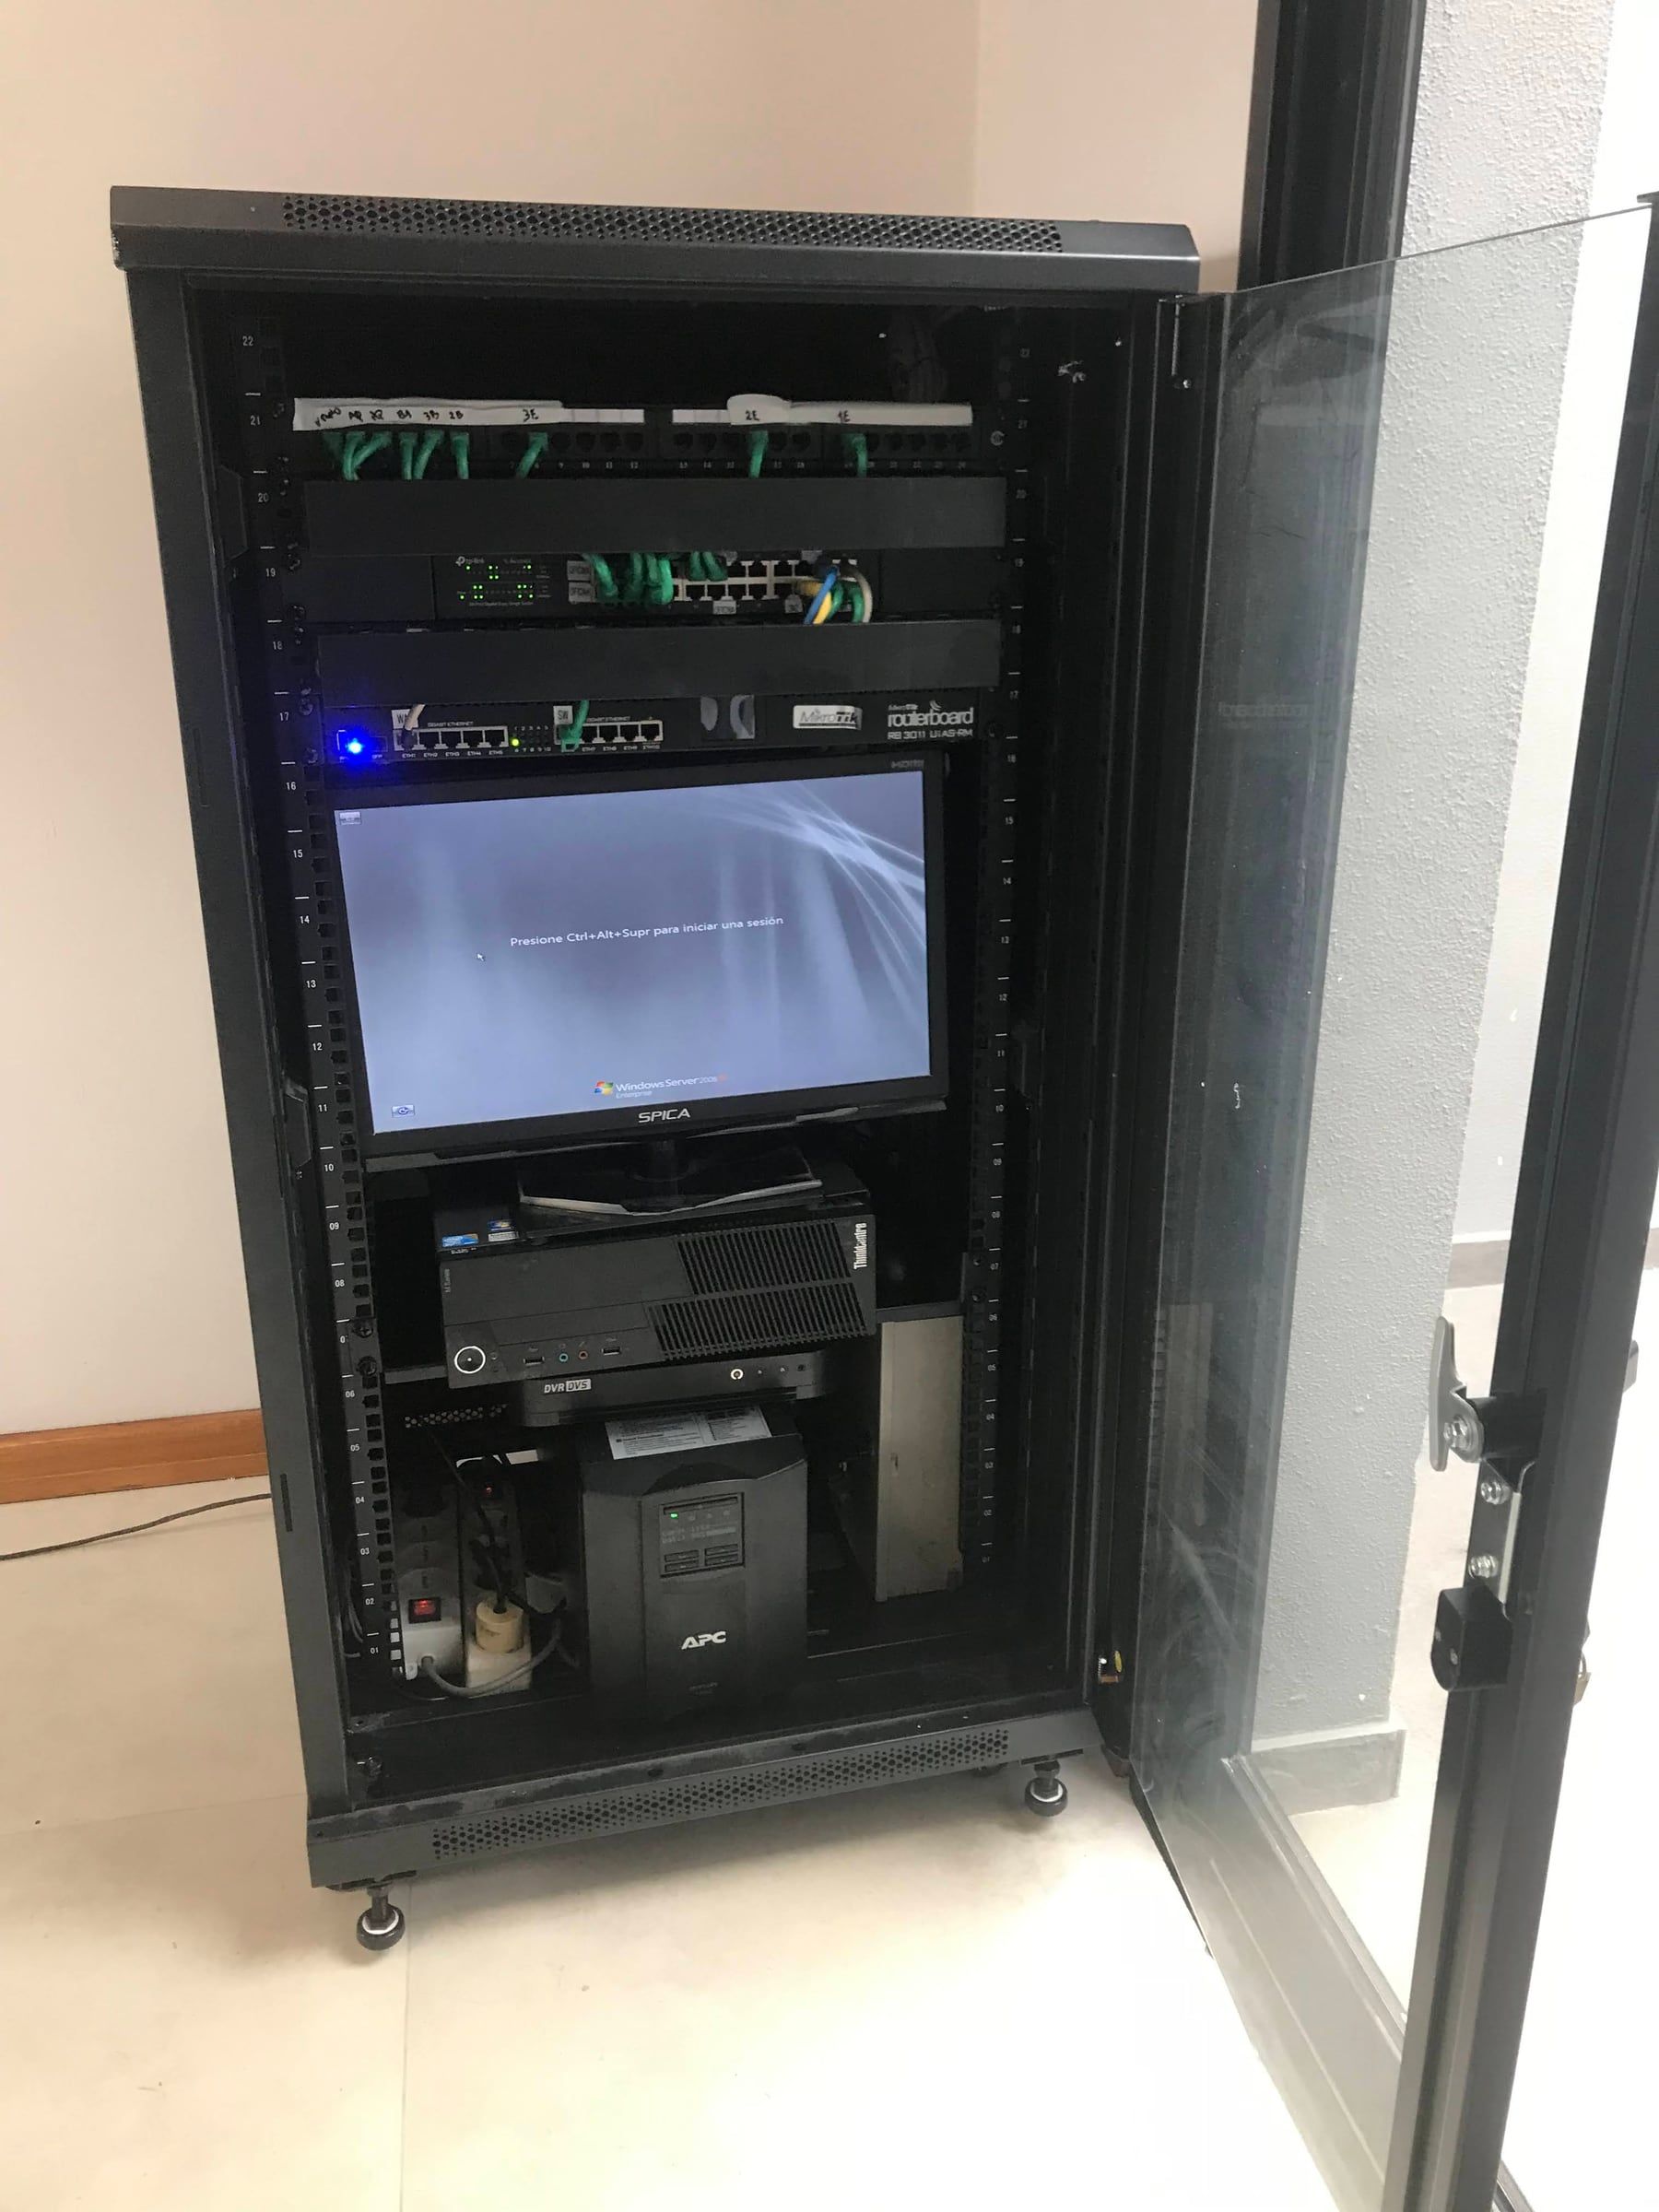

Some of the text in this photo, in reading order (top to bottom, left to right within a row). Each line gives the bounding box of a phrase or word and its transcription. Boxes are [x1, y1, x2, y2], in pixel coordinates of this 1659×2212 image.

[242, 335, 253, 347] 22
[523, 408, 539, 421] 3E
[746, 410, 759, 420] 2E
[251, 415, 261, 426] 21
[258, 492, 269, 502] 20
[265, 568, 276, 577] 19
[273, 641, 283, 650] 18
[280, 712, 288, 721] 17
[888, 707, 974, 727] routerboard
[888, 731, 902, 740] RB
[903, 730, 926, 739] 3011
[287, 782, 296, 791] 16
[294, 849, 303, 858] 15
[300, 915, 310, 924] 14
[511, 916, 783, 947] Presione Ctrl+Alt+Supr para iniciar una sesión
[307, 980, 317, 988] 13
[313, 1042, 323, 1051] 12
[615, 1082, 664, 1092] Windows
[665, 1077, 700, 1088] Server
[616, 1090, 653, 1100] Enterprise
[318, 1104, 327, 1112] 11
[638, 1108, 690, 1124] SPICA
[324, 1163, 334, 1171] 10
[329, 1222, 339, 1230] 09
[335, 1279, 345, 1288] 08
[544, 1381, 588, 1394] DVR DVS
[350, 1443, 359, 1452] 05
[355, 1496, 365, 1504] 04
[681, 1630, 727, 1650] APC
